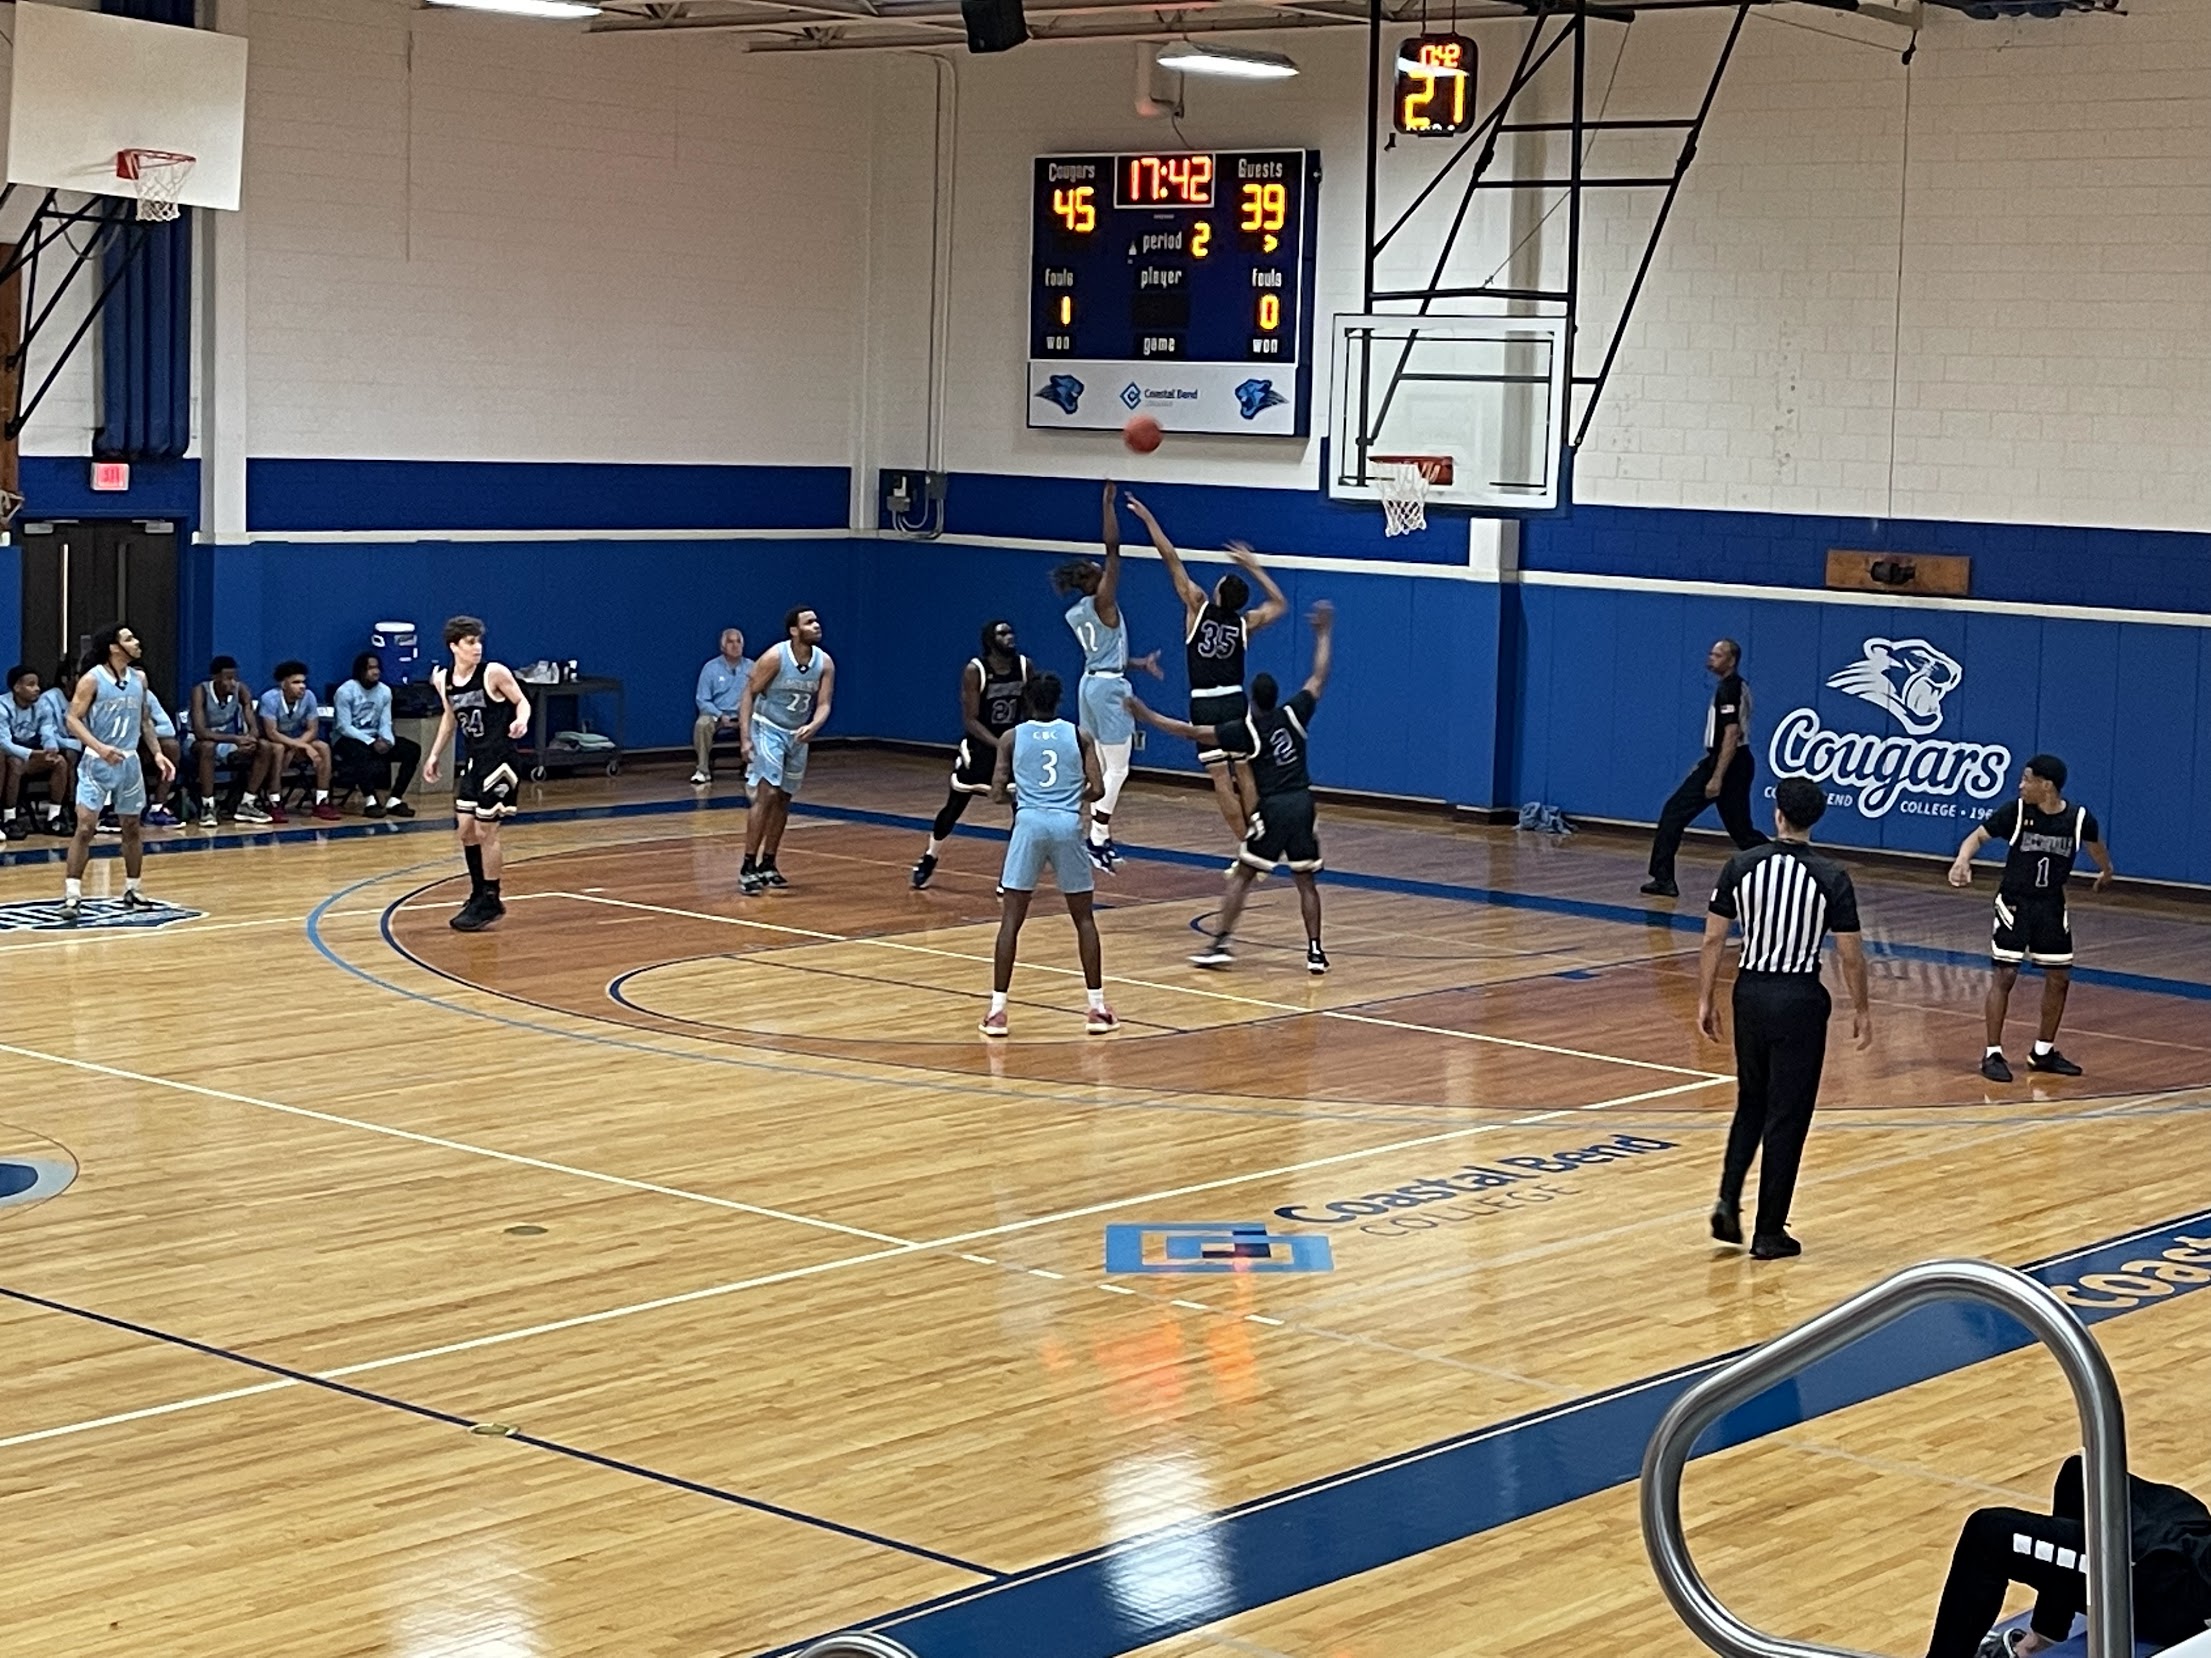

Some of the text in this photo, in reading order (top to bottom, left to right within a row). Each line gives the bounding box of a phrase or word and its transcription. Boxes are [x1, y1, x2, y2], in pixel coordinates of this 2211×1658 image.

[1049, 163, 1095, 182] Cougars
[1131, 156, 1212, 200] 17:42
[1238, 158, 1283, 178] Guests
[1054, 186, 1095, 232] 45
[1241, 184, 1285, 230] 39
[1143, 222, 1211, 257] period 2
[1045, 268, 1073, 286] fouls
[1140, 266, 1182, 289] player
[1252, 268, 1282, 287] fouls
[1060, 295, 1071, 325] 1
[1260, 294, 1280, 330] 0
[1046, 336, 1070, 350] won
[1143, 338, 1175, 355] game
[1252, 338, 1278, 353] won
[1198, 620, 1239, 659] 35
[111, 715, 130, 738] 11
[1270, 728, 1298, 767] 2
[1769, 708, 2011, 818] Cougars
[1039, 749, 1058, 788] 3
[1900, 800, 1957, 818] COLLEGE
[2035, 857, 2050, 888] 1
[1274, 1134, 1680, 1223] Coastal Bend
[1360, 1183, 1582, 1236] COLLEGE
